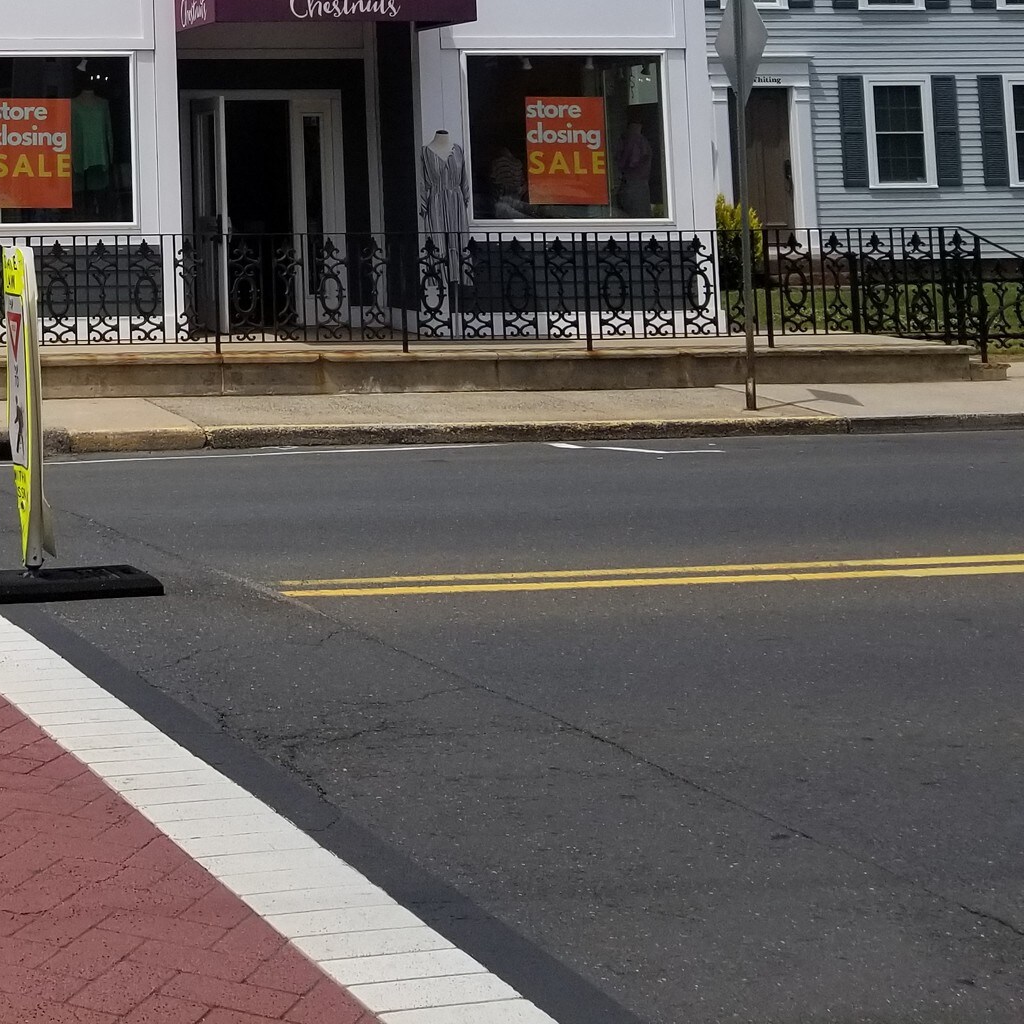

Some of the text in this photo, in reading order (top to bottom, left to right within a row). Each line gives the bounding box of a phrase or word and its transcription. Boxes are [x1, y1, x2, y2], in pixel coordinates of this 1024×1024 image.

[526, 100, 581, 118] store
[526, 122, 601, 150] closing
[529, 151, 606, 175] SALE
